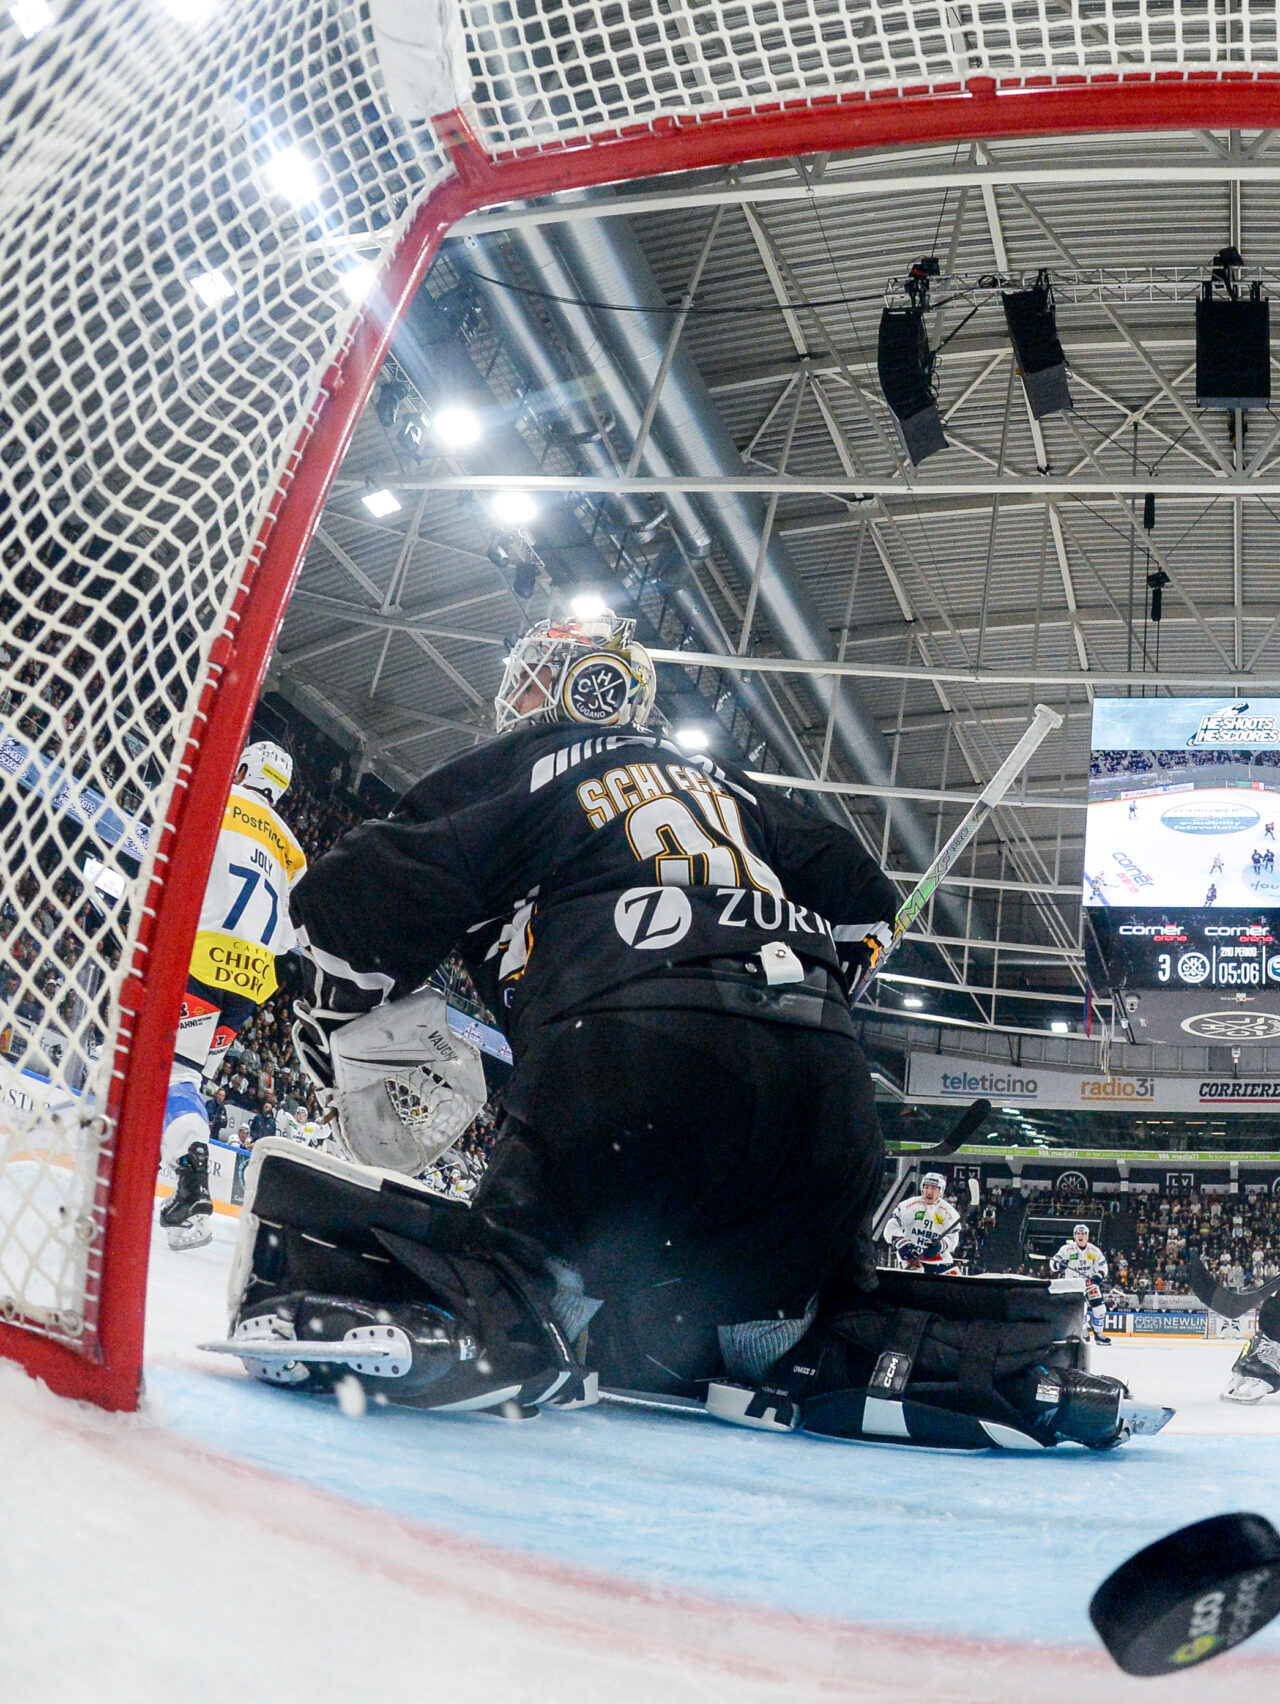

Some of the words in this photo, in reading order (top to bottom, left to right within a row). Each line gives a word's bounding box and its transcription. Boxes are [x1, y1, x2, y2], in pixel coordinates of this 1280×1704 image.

[577, 701, 606, 720] LUGANO
[250, 848, 273, 877] JOLY
[1239, 935, 1274, 943] arena
[1235, 947, 1257, 957] PERIOD
[1158, 954, 1170, 982] 3
[1218, 962, 1260, 984] 05:06
[941, 1072, 1038, 1094] teleticino
[1081, 1078, 1154, 1097] radio3i
[924, 1219, 933, 1230] 91
[884, 1357, 899, 1388] CCM
